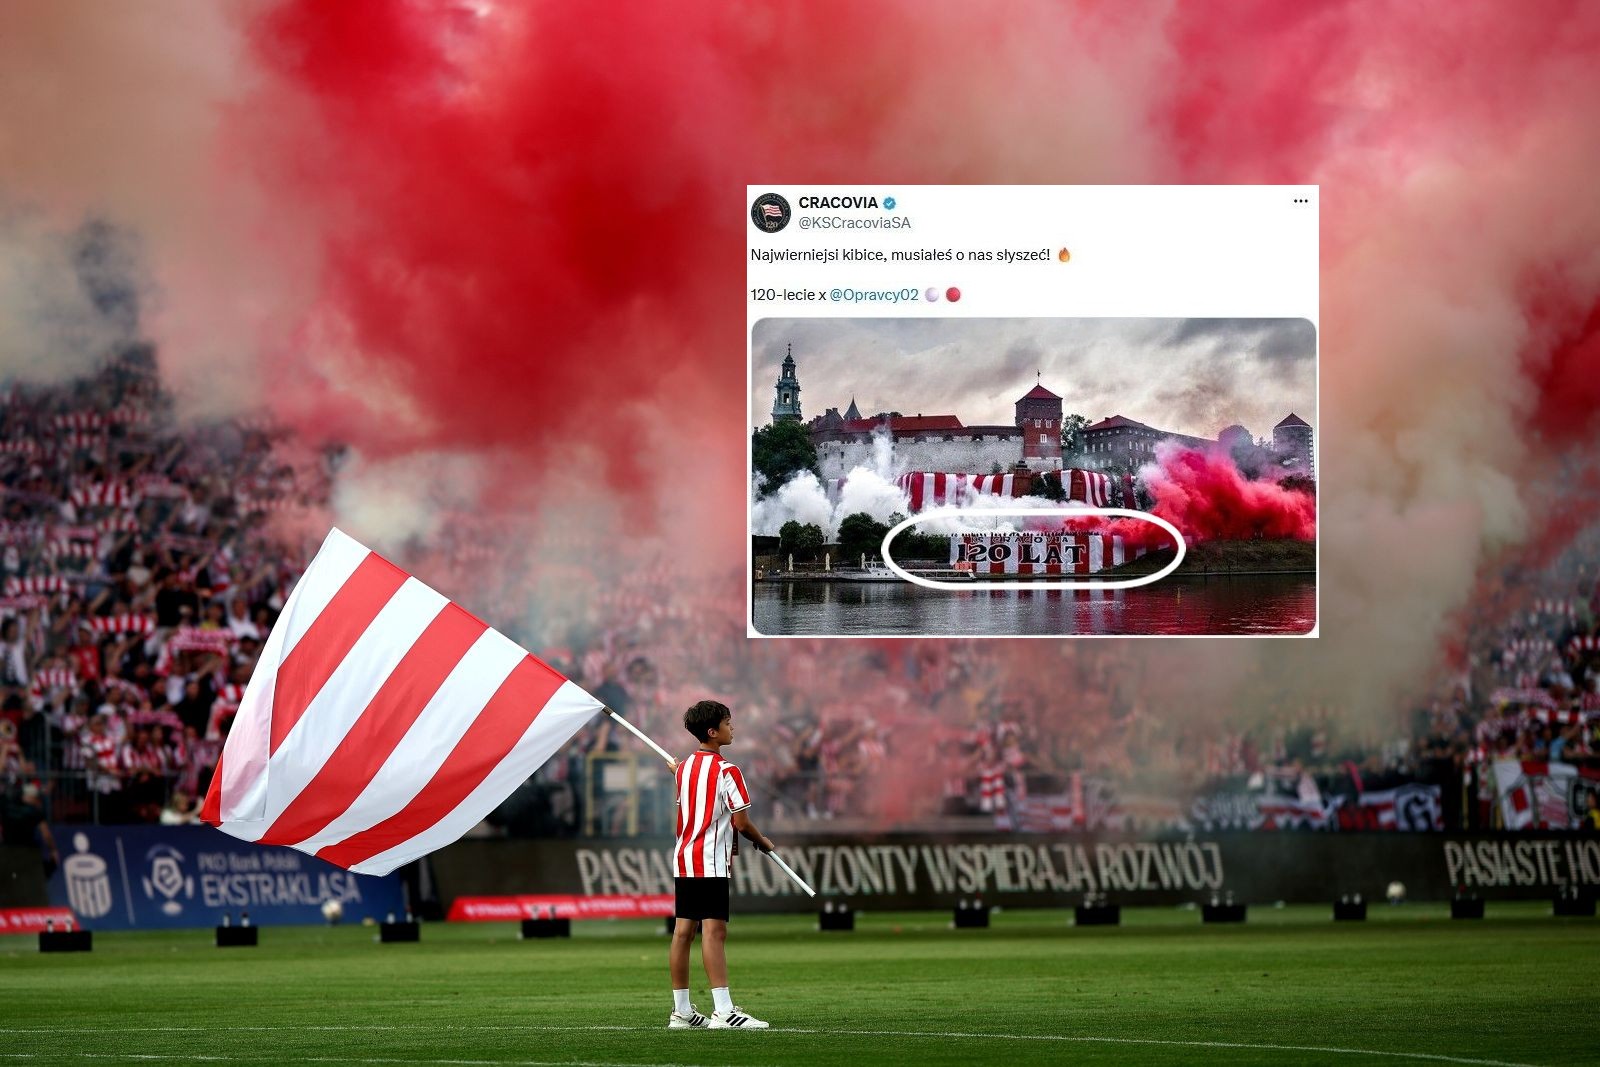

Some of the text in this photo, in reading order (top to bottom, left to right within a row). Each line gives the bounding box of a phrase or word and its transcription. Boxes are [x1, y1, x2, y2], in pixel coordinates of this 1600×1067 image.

[957, 543, 1087, 565] 120 LAT
[576, 847, 675, 897] PASIA
[732, 844, 918, 896] HORYZONTY
[1096, 832, 1224, 891] ROZWÓJ
[1443, 840, 1560, 886] PASIASTE
[200, 871, 363, 907] EKSTRAKLASA
